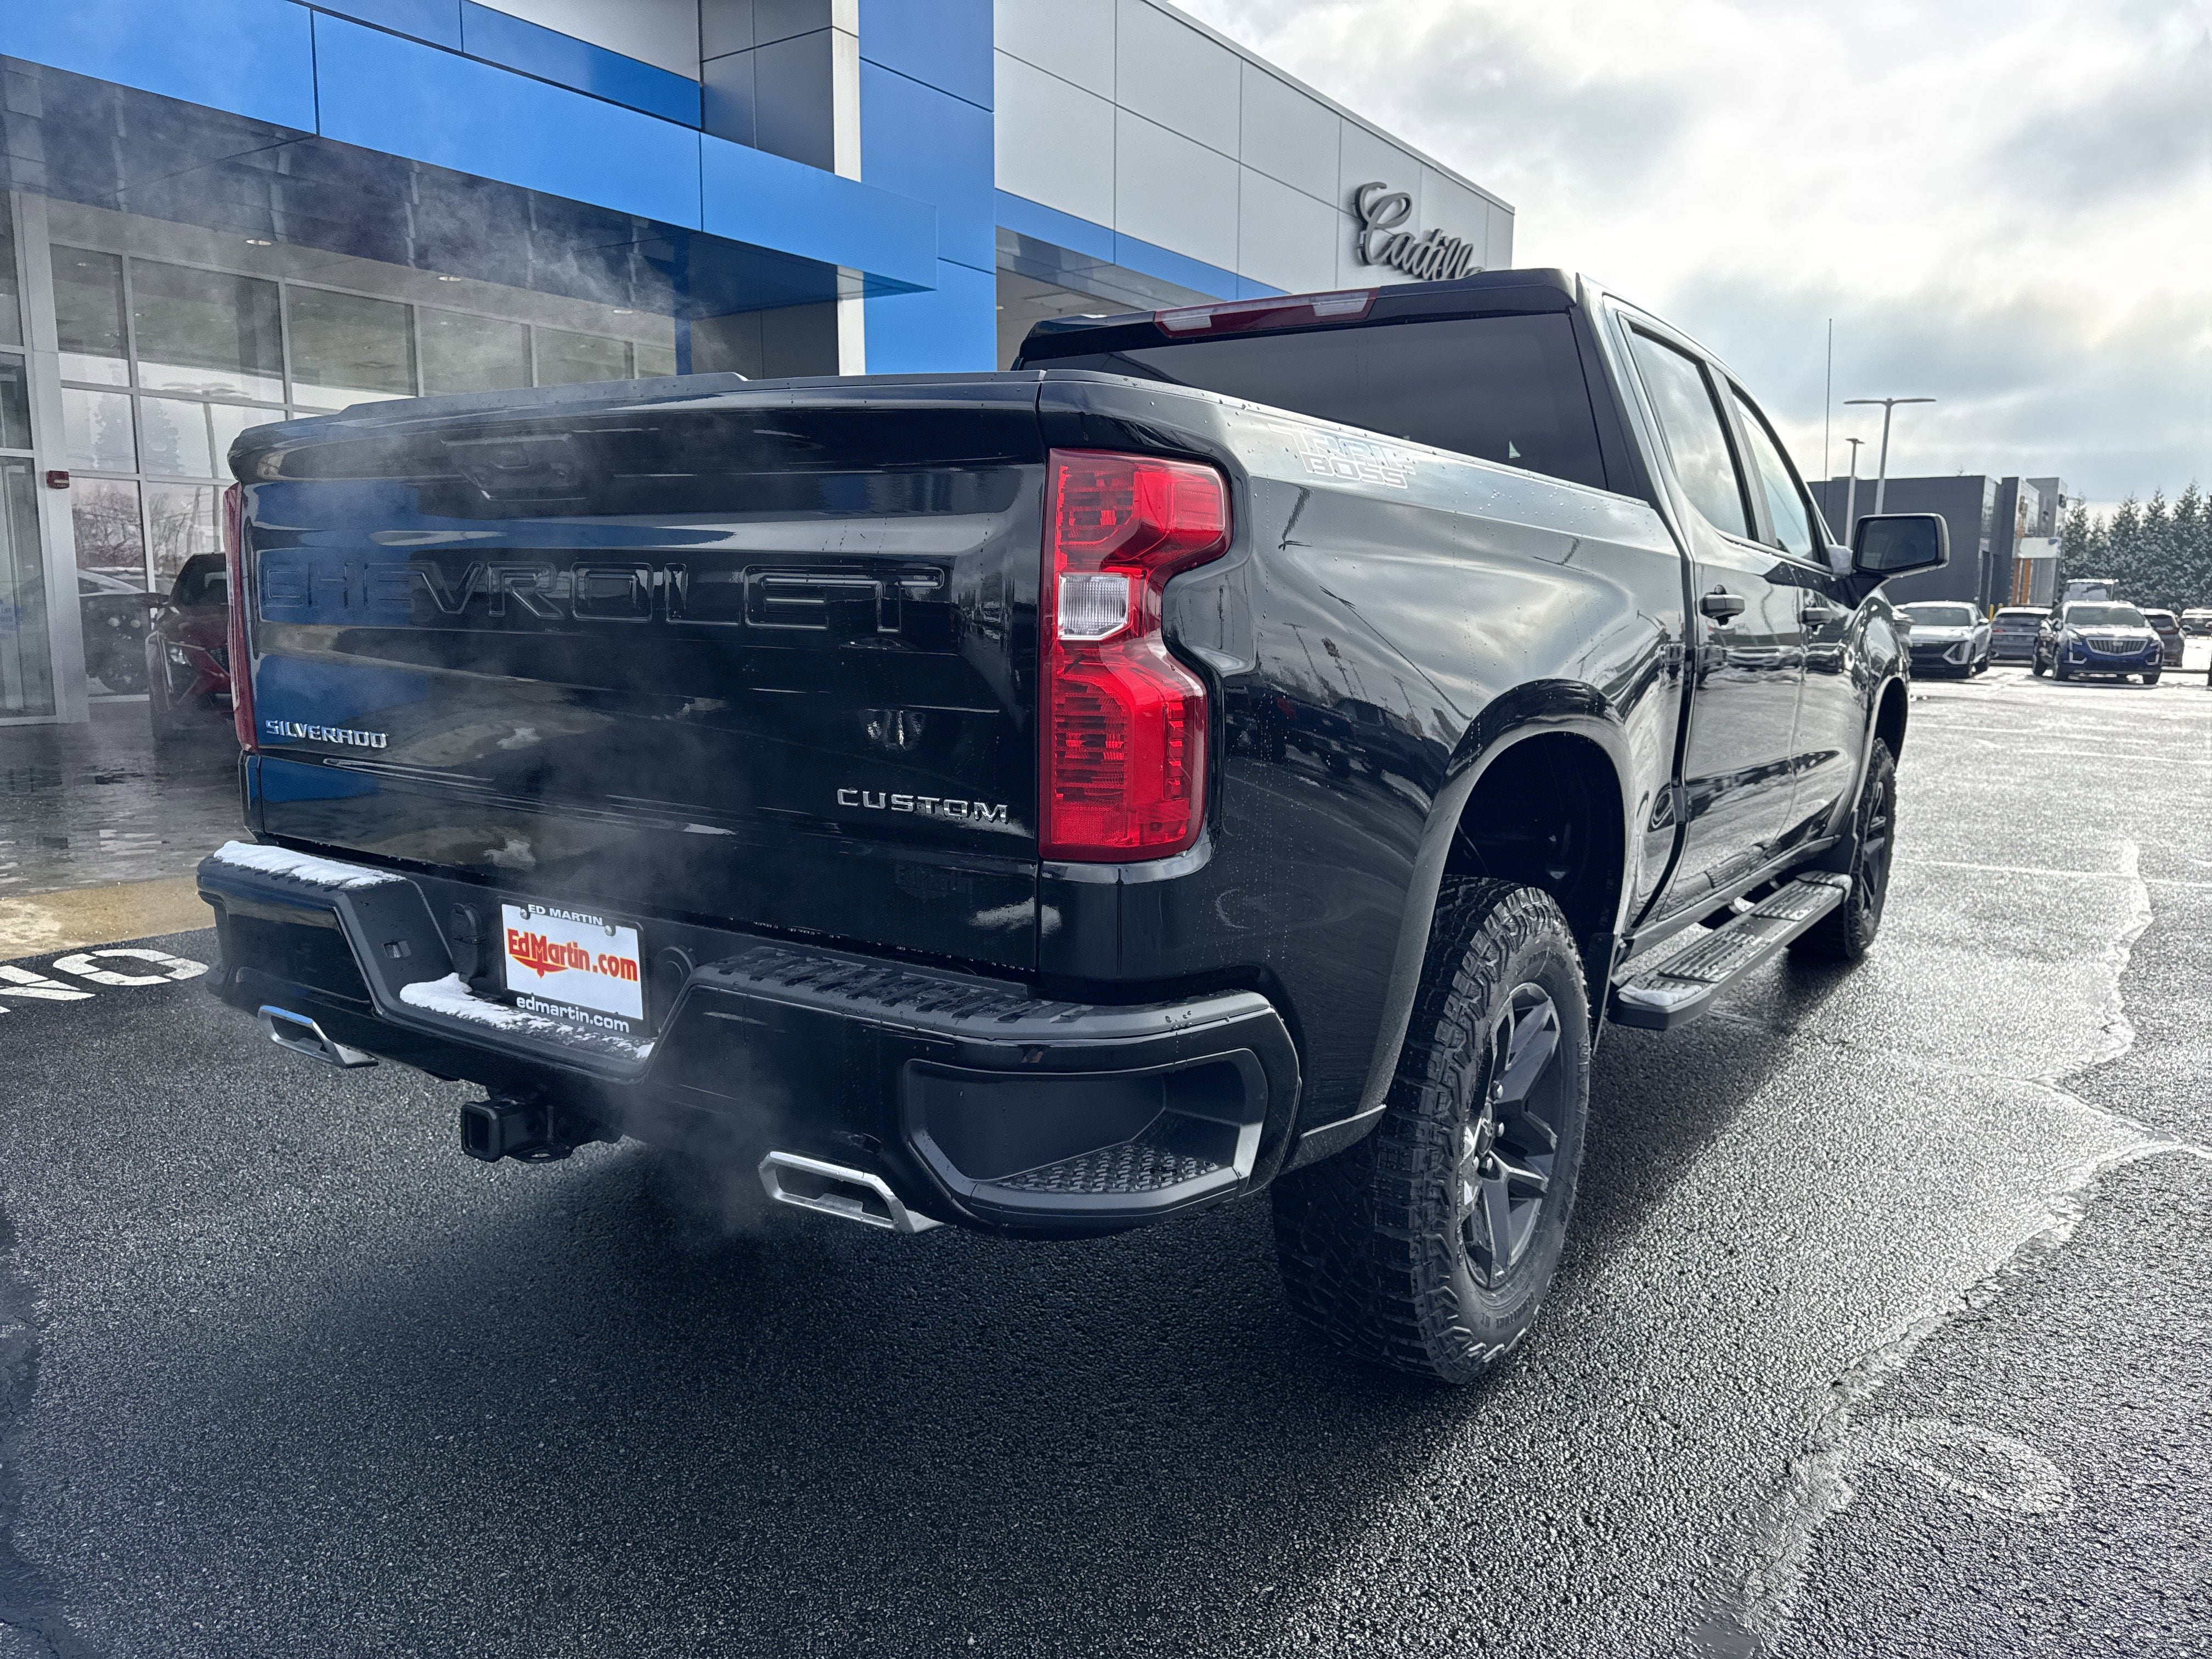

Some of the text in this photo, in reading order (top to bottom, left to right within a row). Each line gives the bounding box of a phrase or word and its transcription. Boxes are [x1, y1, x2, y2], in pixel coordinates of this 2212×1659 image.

[1267, 423, 1417, 475] TRAIL
[1300, 452, 1408, 489] BOSS
[260, 558, 945, 634] CHEVROLET
[266, 720, 387, 748] SILVERADO
[837, 788, 1008, 823] CUSTOM
[528, 904, 603, 926] ED MARTIN
[506, 928, 639, 982] EdMartin.com
[516, 996, 629, 1034] edmartin.com
